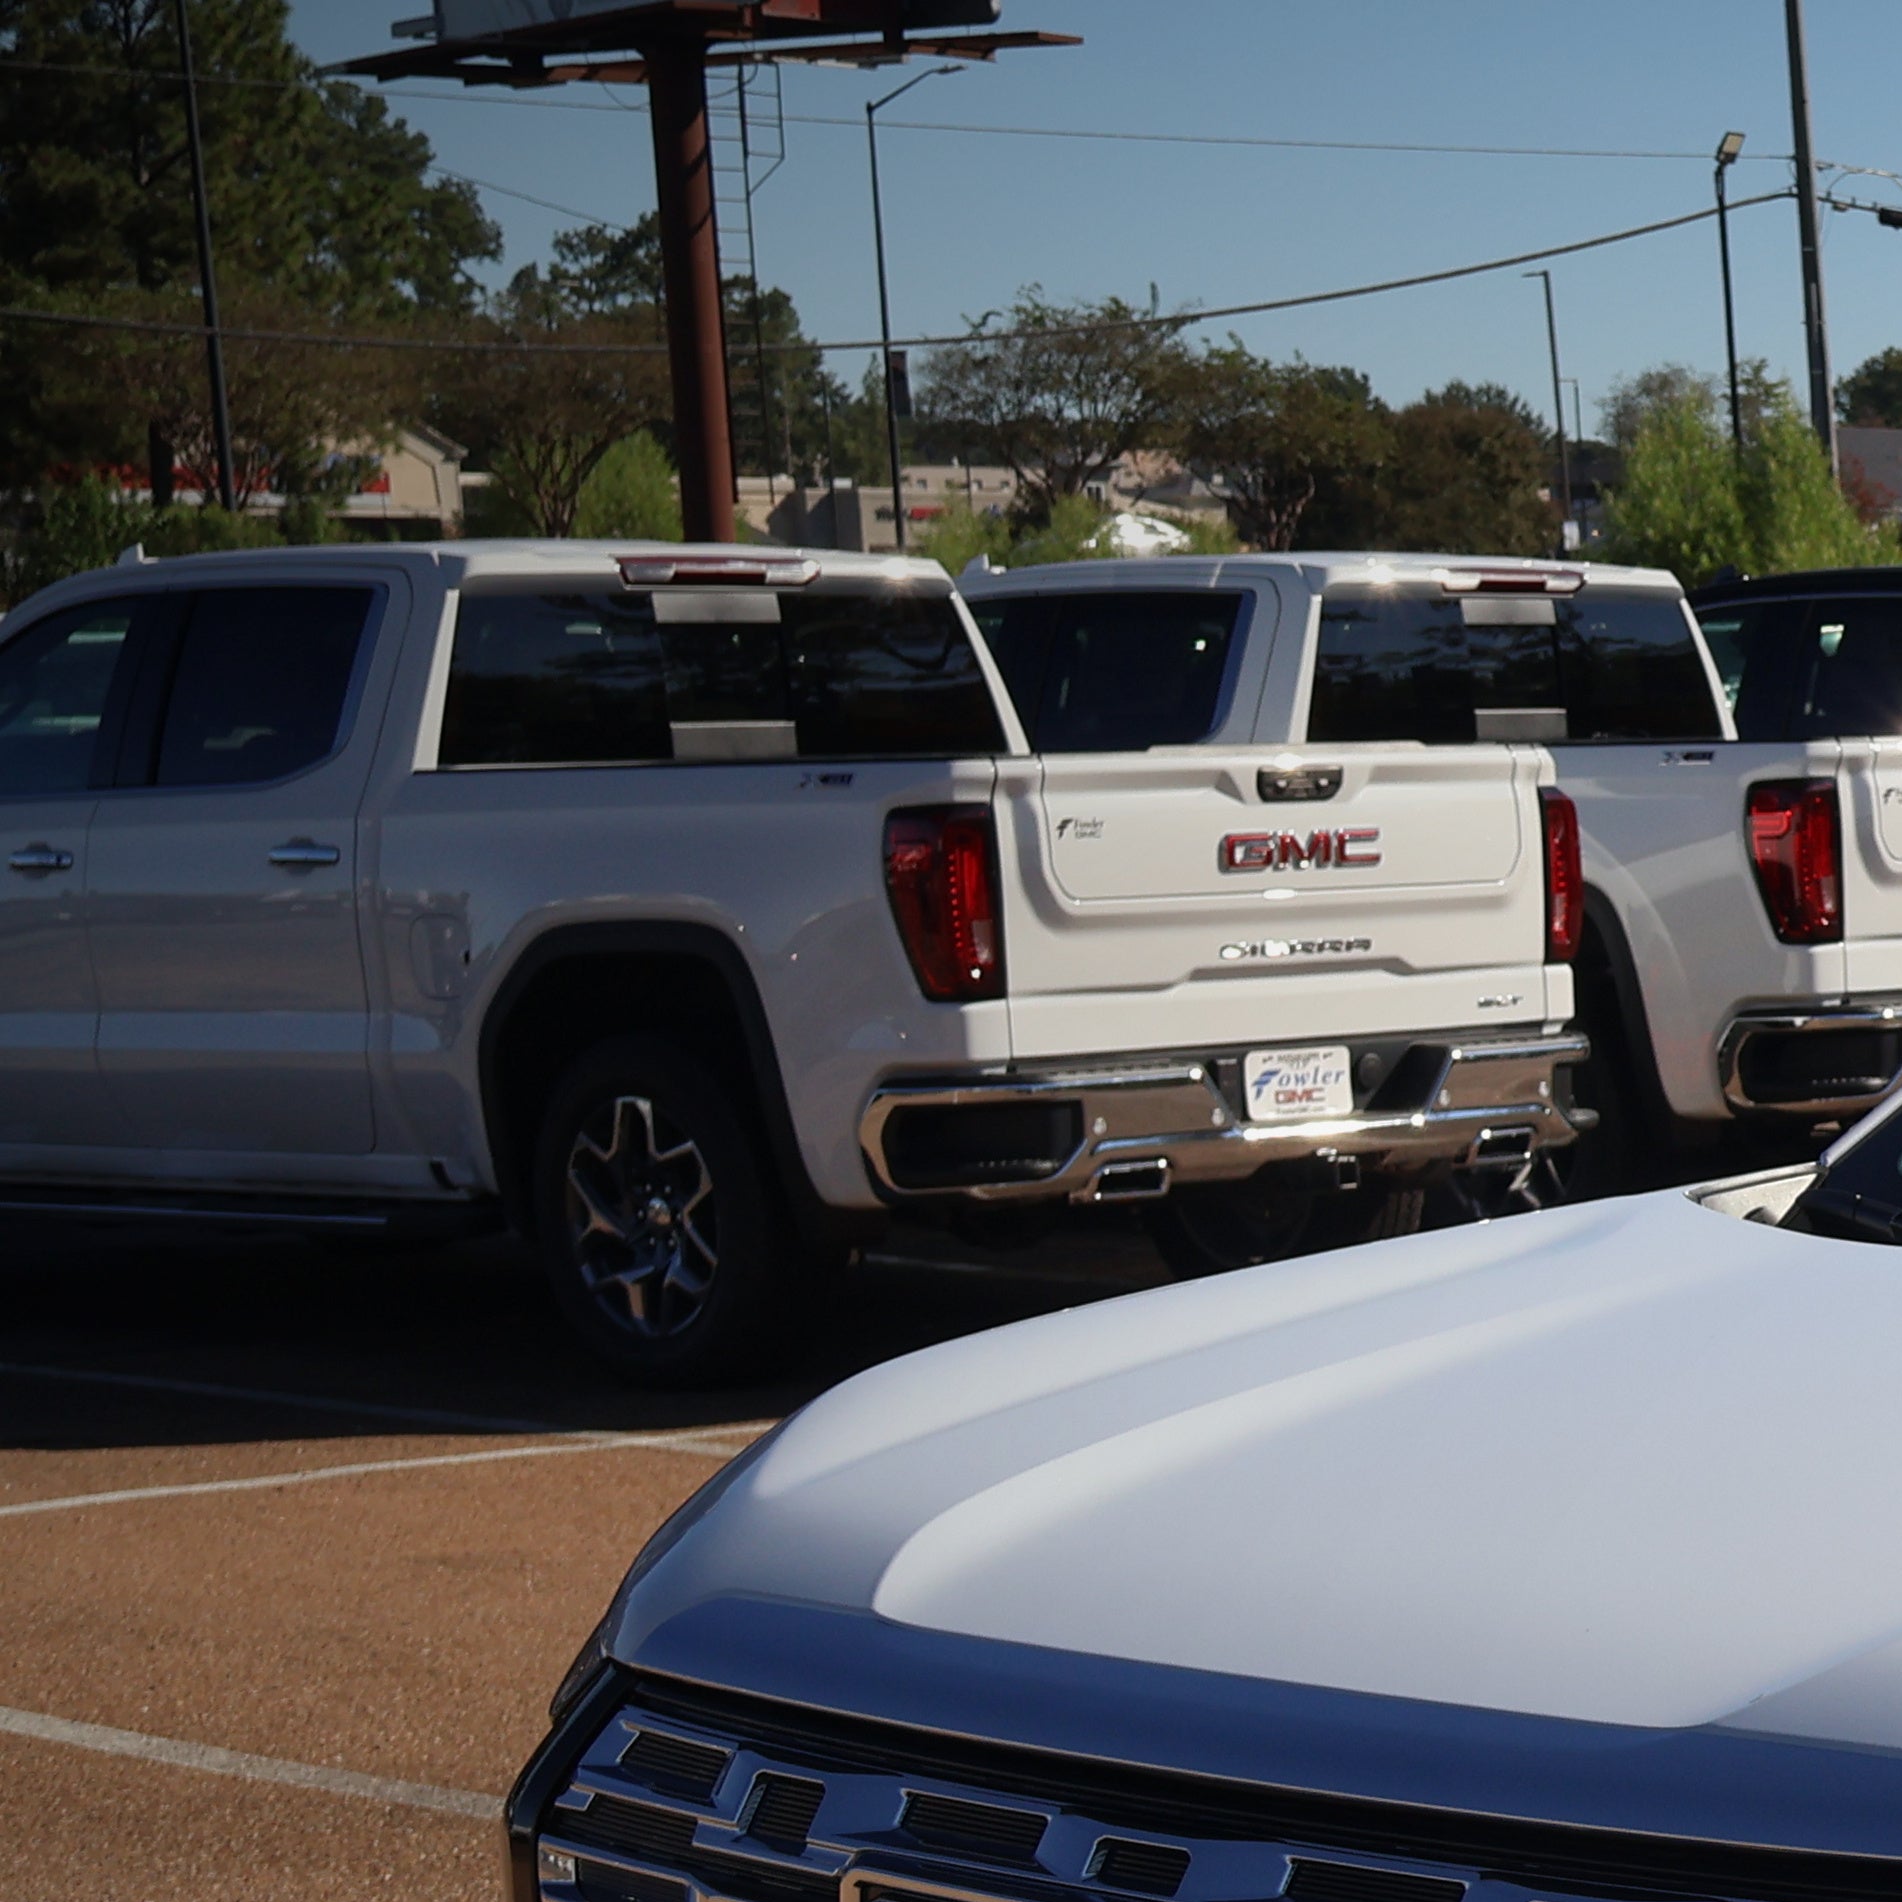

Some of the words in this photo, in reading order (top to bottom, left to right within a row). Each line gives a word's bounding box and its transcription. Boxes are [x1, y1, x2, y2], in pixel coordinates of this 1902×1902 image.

[1217, 827, 1381, 874] GMC
[1252, 1066, 1345, 1100] Fowler
[1275, 1088, 1325, 1104] GMC
